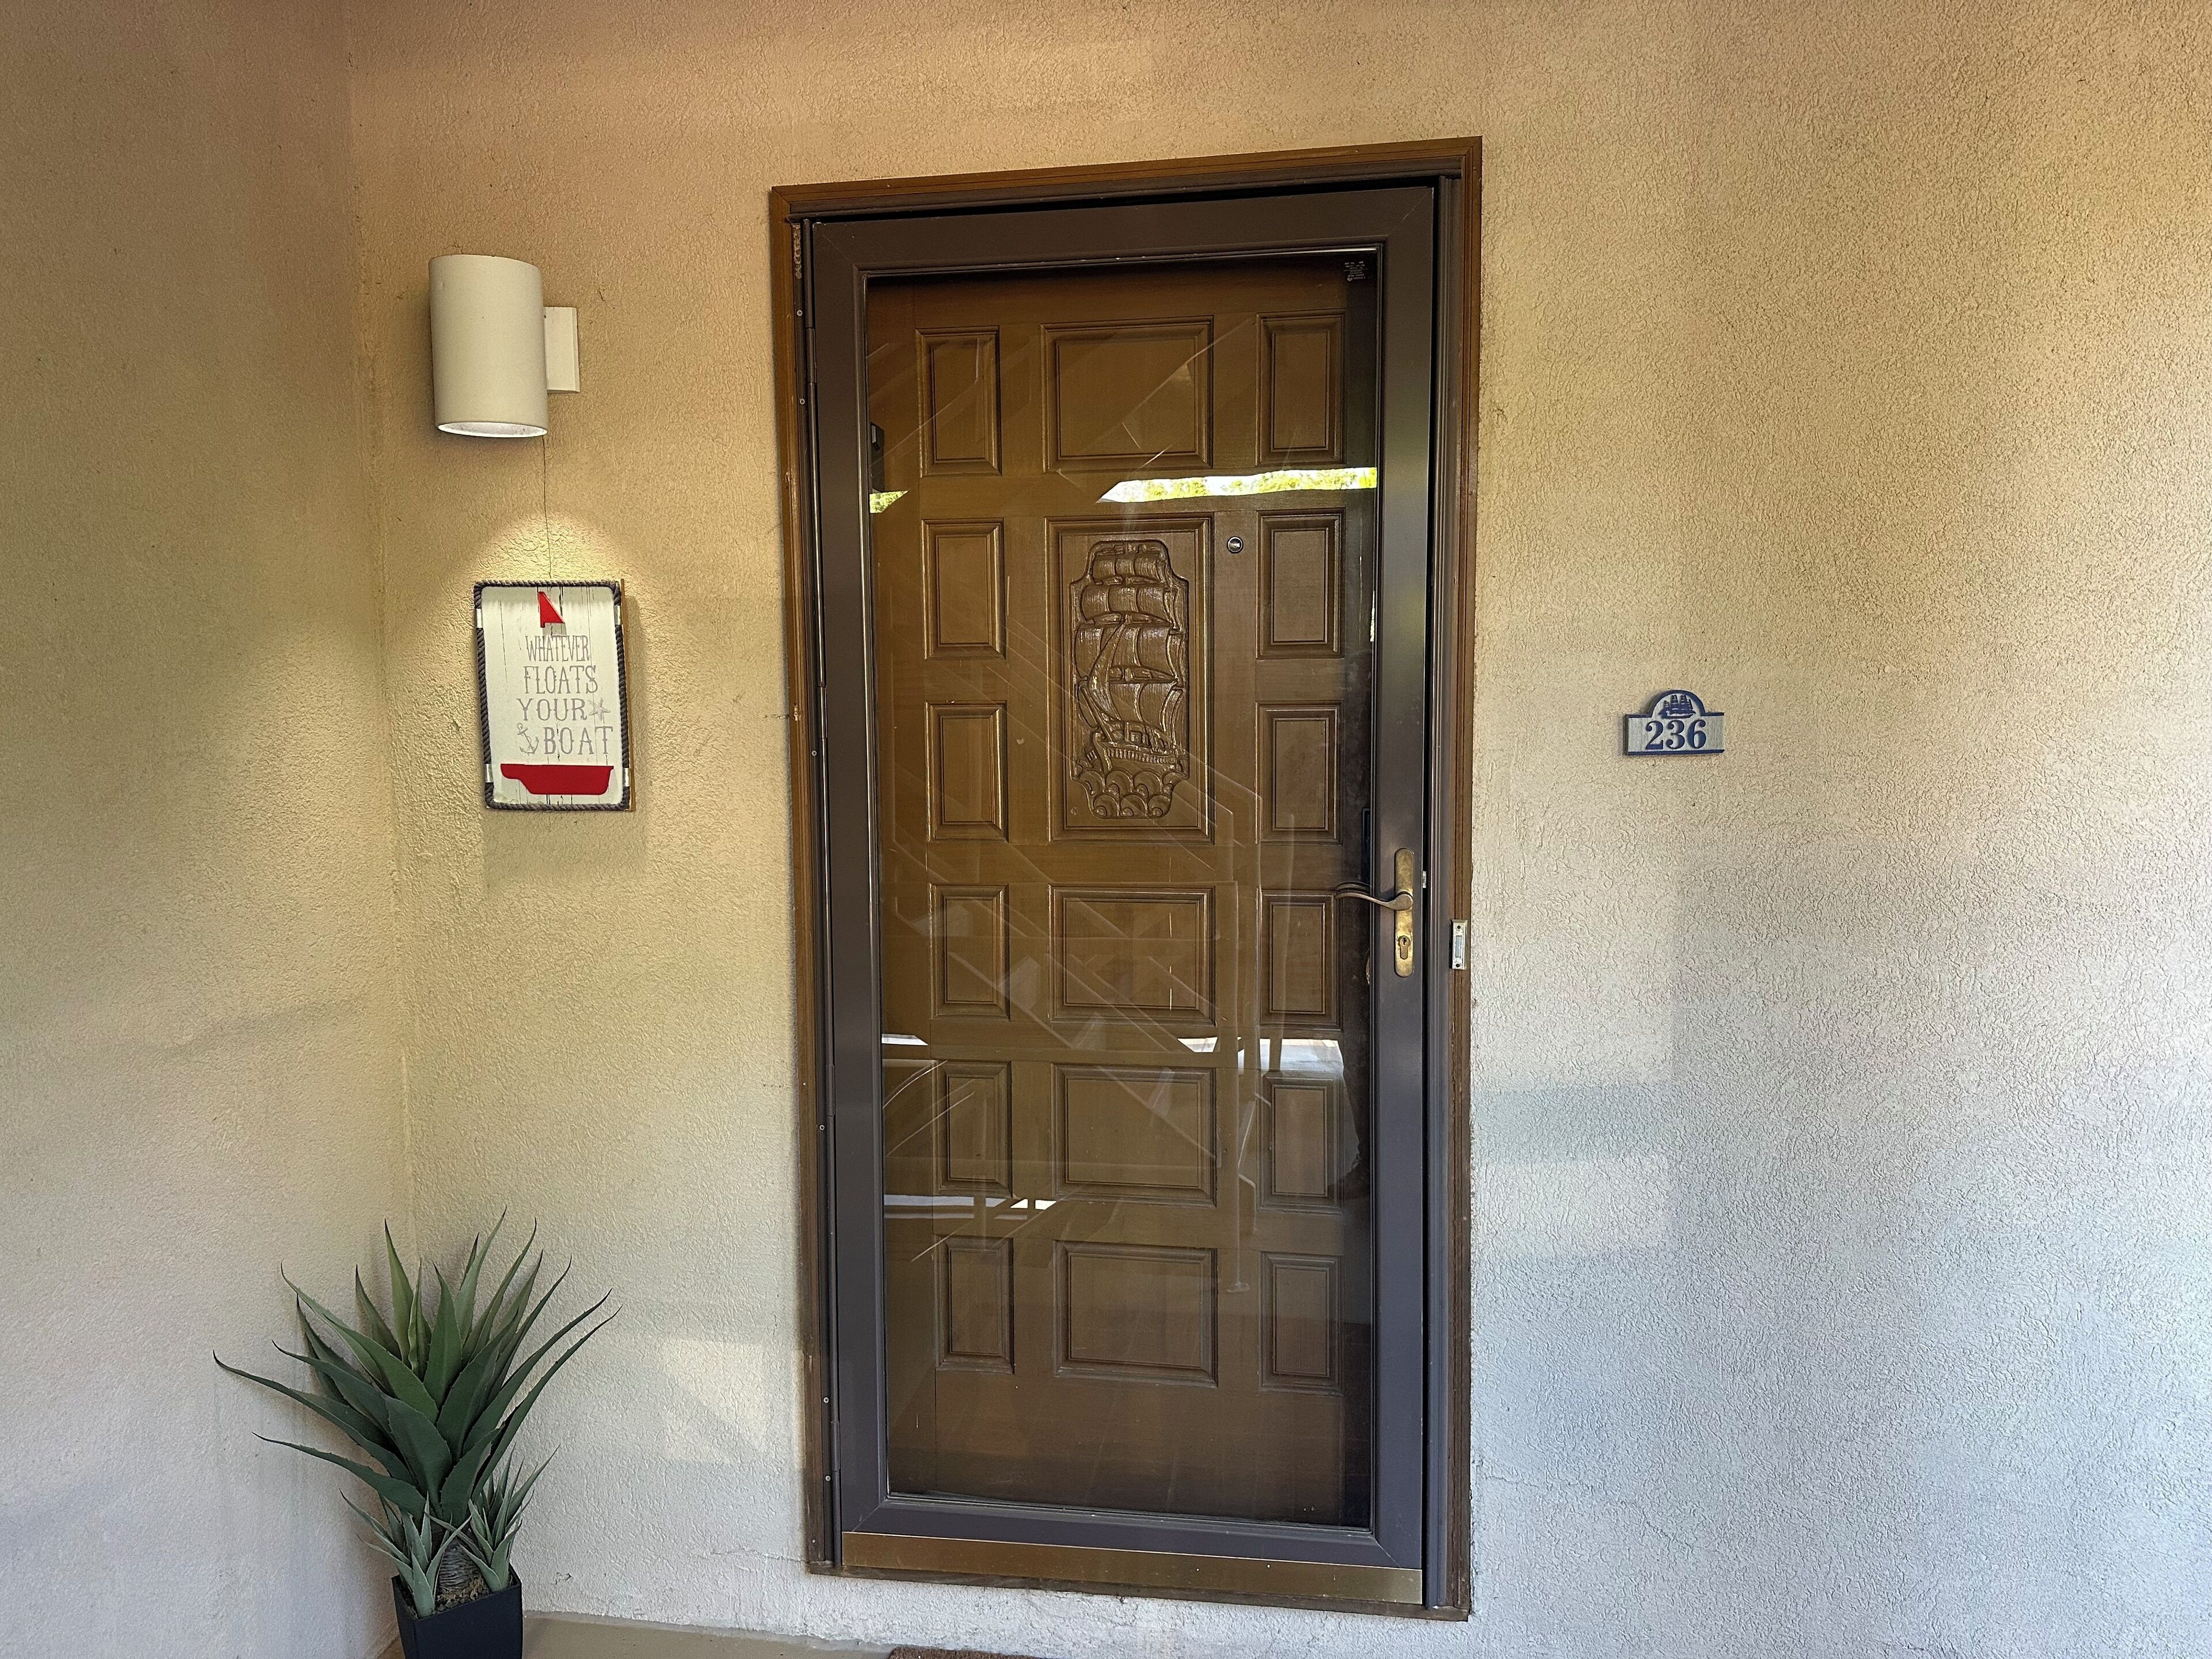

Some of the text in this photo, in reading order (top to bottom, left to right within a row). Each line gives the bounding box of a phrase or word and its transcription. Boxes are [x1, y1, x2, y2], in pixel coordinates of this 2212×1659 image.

[525, 635, 590, 662] WHATEVER
[524, 665, 598, 694] FLOATS
[517, 698, 587, 721] YOUR
[544, 726, 613, 755] BOAT
[1645, 720, 1707, 749] 236
